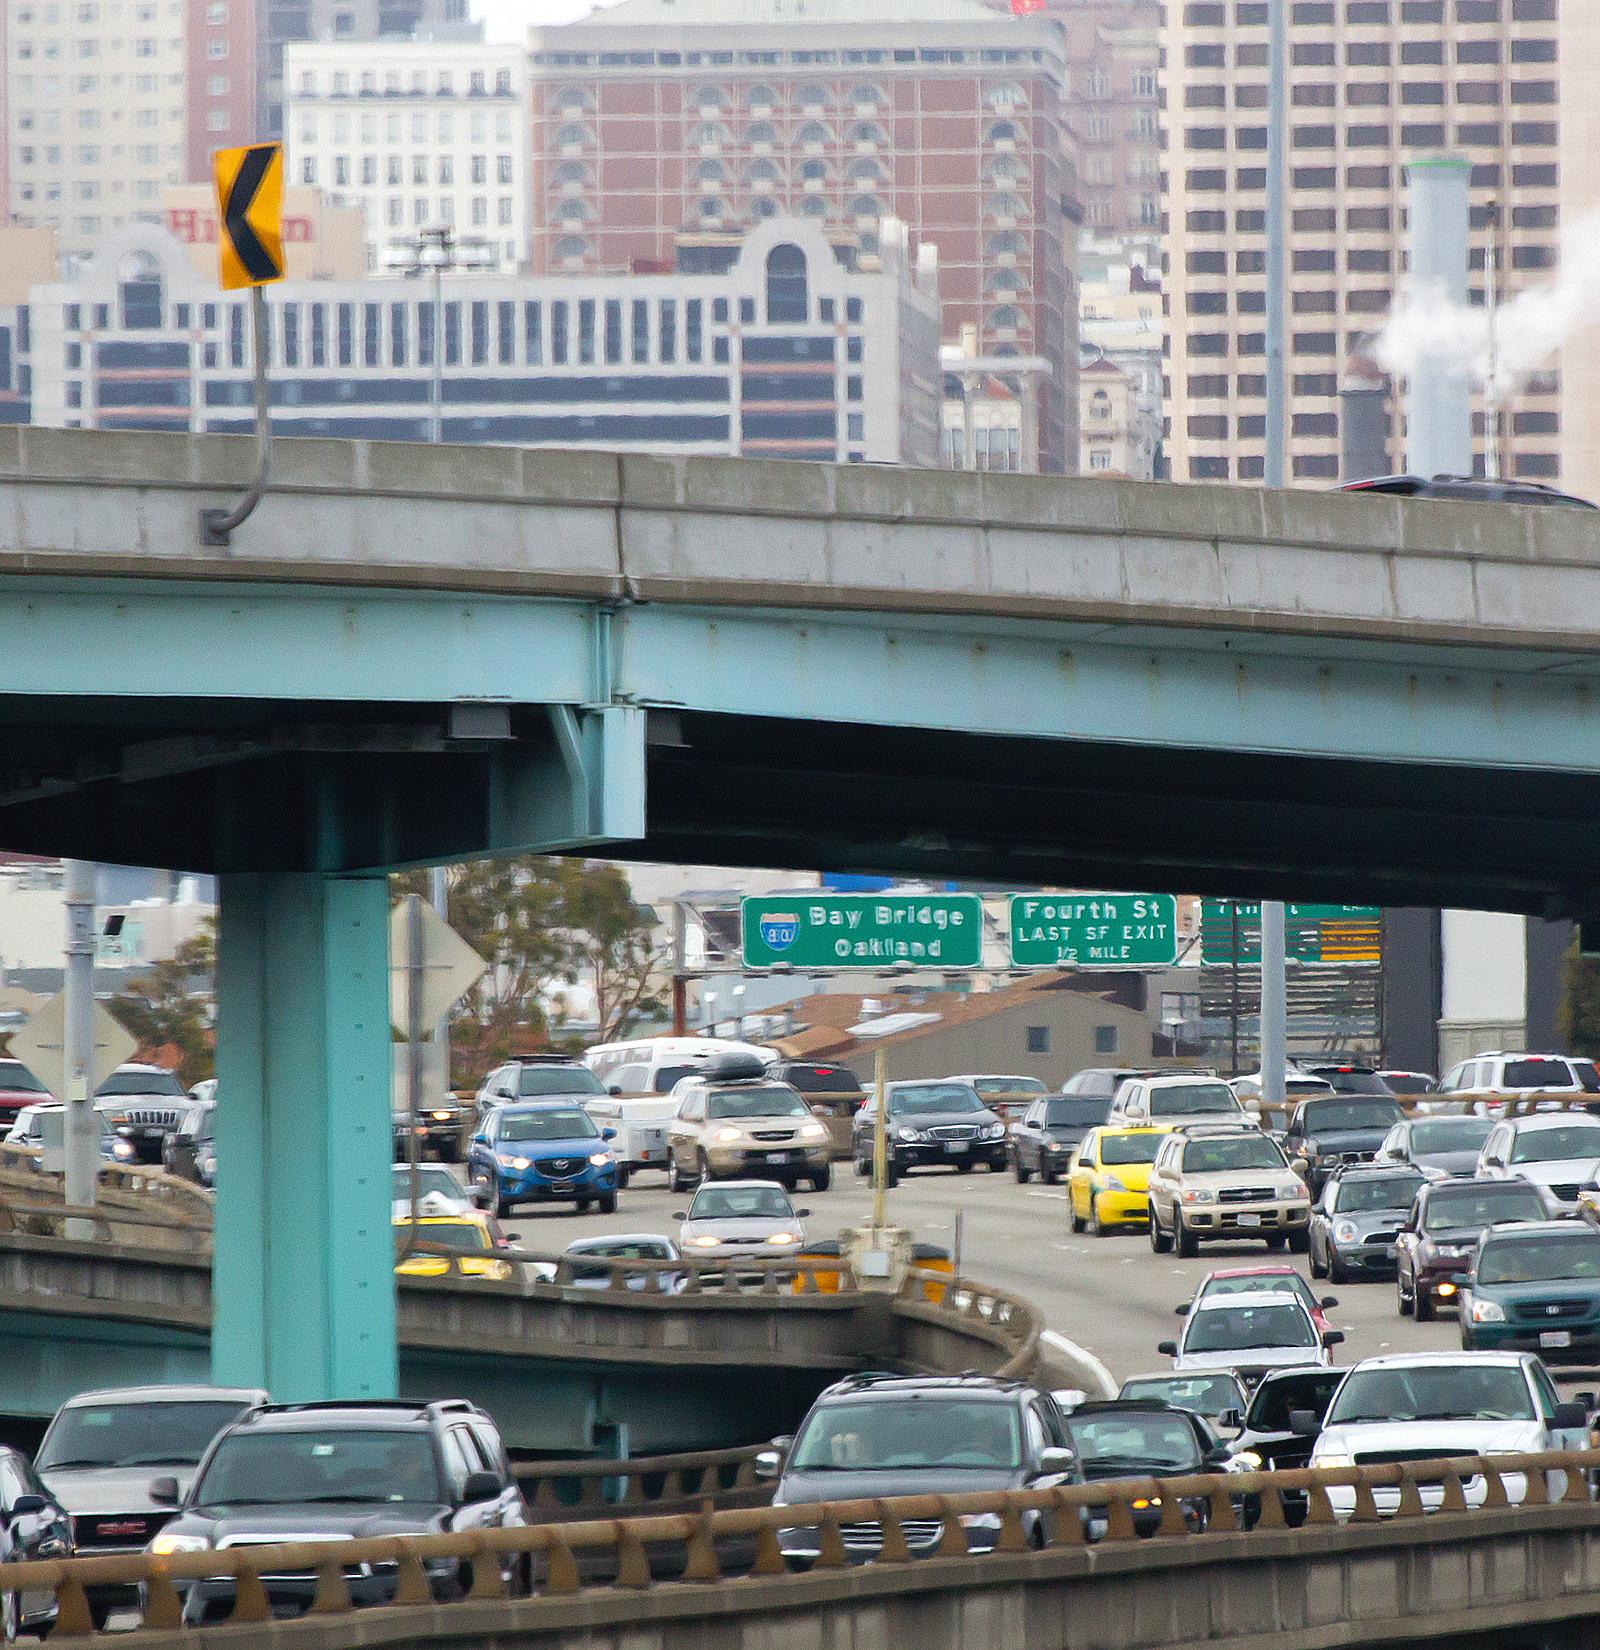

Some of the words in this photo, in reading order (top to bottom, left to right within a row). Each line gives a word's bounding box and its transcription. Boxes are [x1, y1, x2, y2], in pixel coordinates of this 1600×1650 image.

[168, 207, 312, 243] Hin
[809, 906, 863, 928] Bay
[875, 905, 964, 930] Bridge
[1024, 902, 1117, 919] Fourth
[1133, 900, 1160, 919] St
[768, 927, 794, 943] 80
[1018, 927, 1072, 942] LAST
[1086, 926, 1110, 941] SF
[1123, 925, 1167, 940] EXIT
[835, 938, 942, 957] Oakland
[1057, 947, 1078, 960] 1/2
[1090, 946, 1131, 959] MILE
[96, 1521, 147, 1535] GMC
